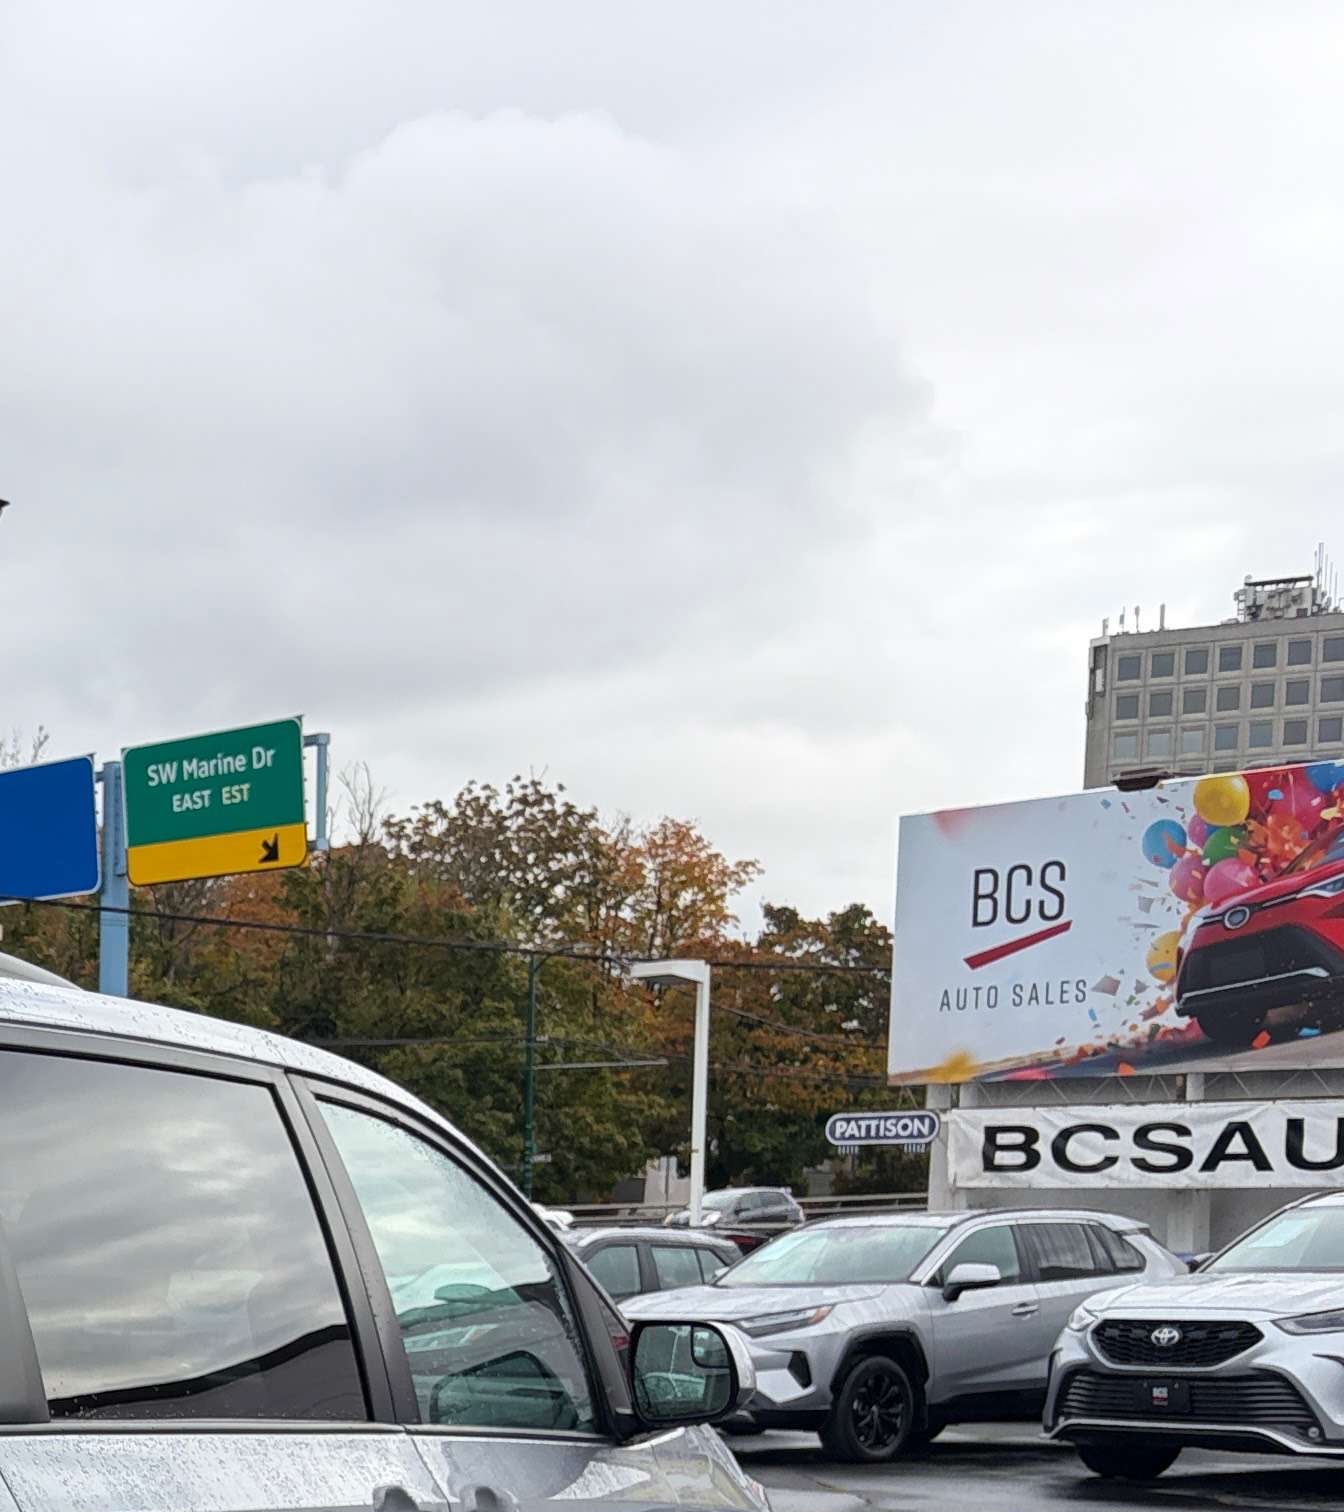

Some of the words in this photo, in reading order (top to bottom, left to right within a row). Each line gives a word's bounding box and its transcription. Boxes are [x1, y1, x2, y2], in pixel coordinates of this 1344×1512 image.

[147, 761, 178, 787] SW
[182, 752, 246, 781] Marine
[252, 746, 276, 770] Dr
[172, 789, 211, 813] EAST
[222, 783, 250, 805] EST
[972, 860, 1066, 928] BCS
[939, 985, 999, 1012] AUTO
[1011, 979, 1087, 1007] SALES
[834, 1117, 931, 1139] PATTISON
[982, 1117, 1344, 1174] BCSAU
